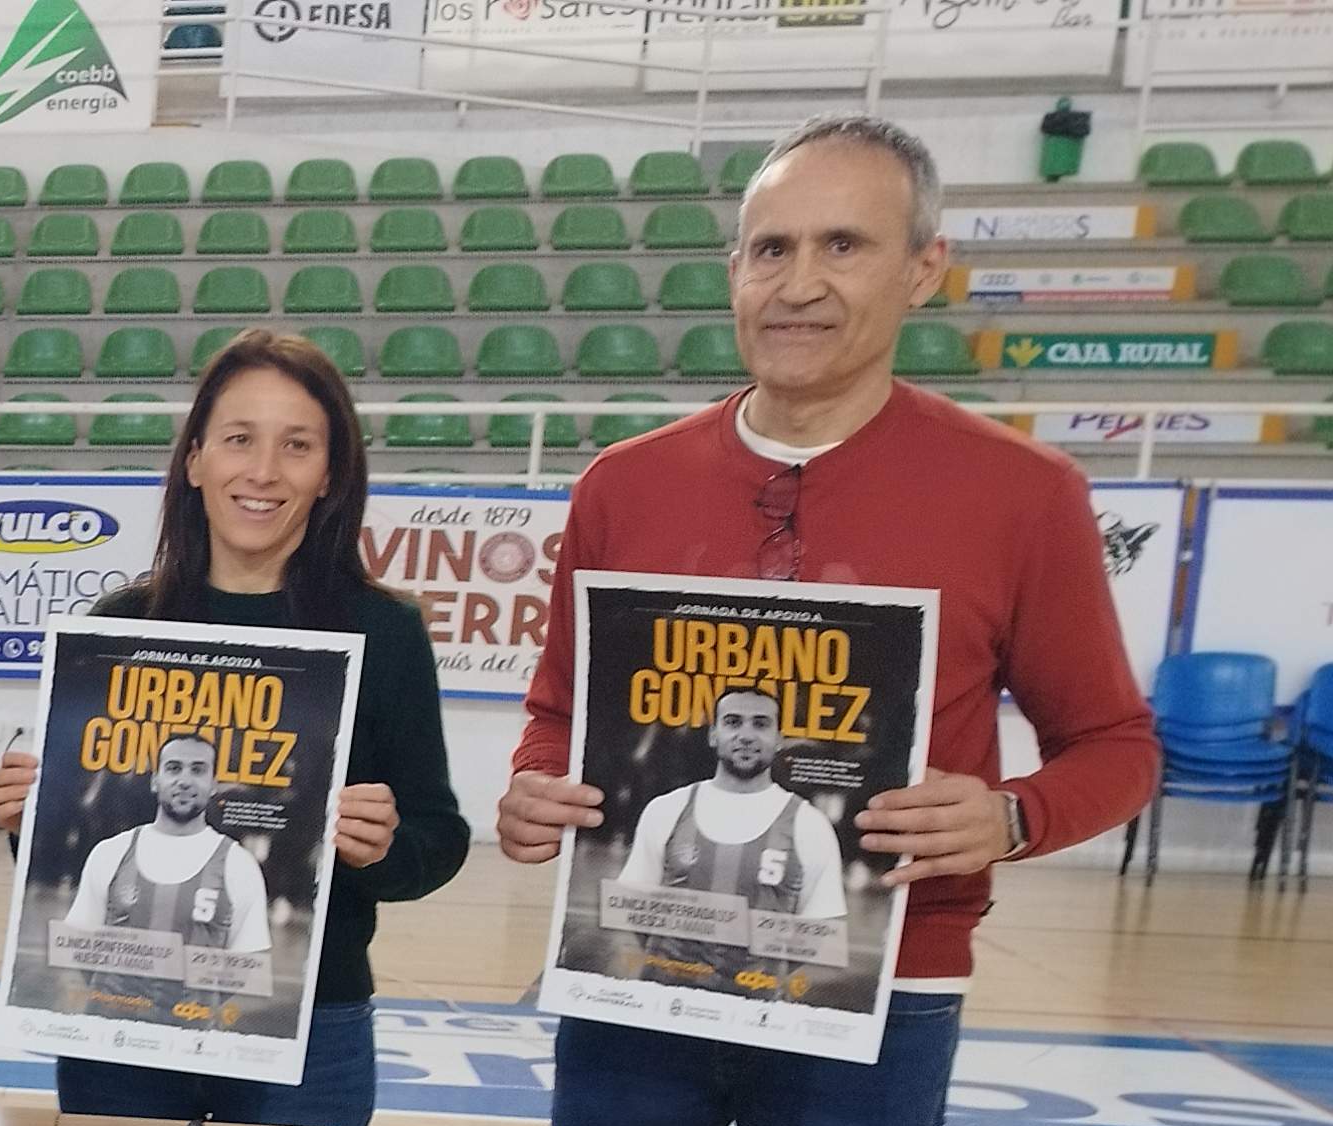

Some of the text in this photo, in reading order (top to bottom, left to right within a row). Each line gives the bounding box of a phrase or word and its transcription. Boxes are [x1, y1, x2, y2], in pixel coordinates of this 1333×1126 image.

[55, 63, 117, 85] coebb
[45, 91, 118, 113] energía
[1046, 342, 1209, 364] CAJA RURAL
[410, 504, 532, 528] desde 1879
[358, 525, 566, 586] VINOS
[673, 603, 739, 618] JORNADA
[764, 609, 811, 622] APOYO
[652, 617, 850, 686] URBANO
[106, 665, 285, 732] URBANO
[757, 848, 789, 887] 5
[192, 886, 221, 923] 5
